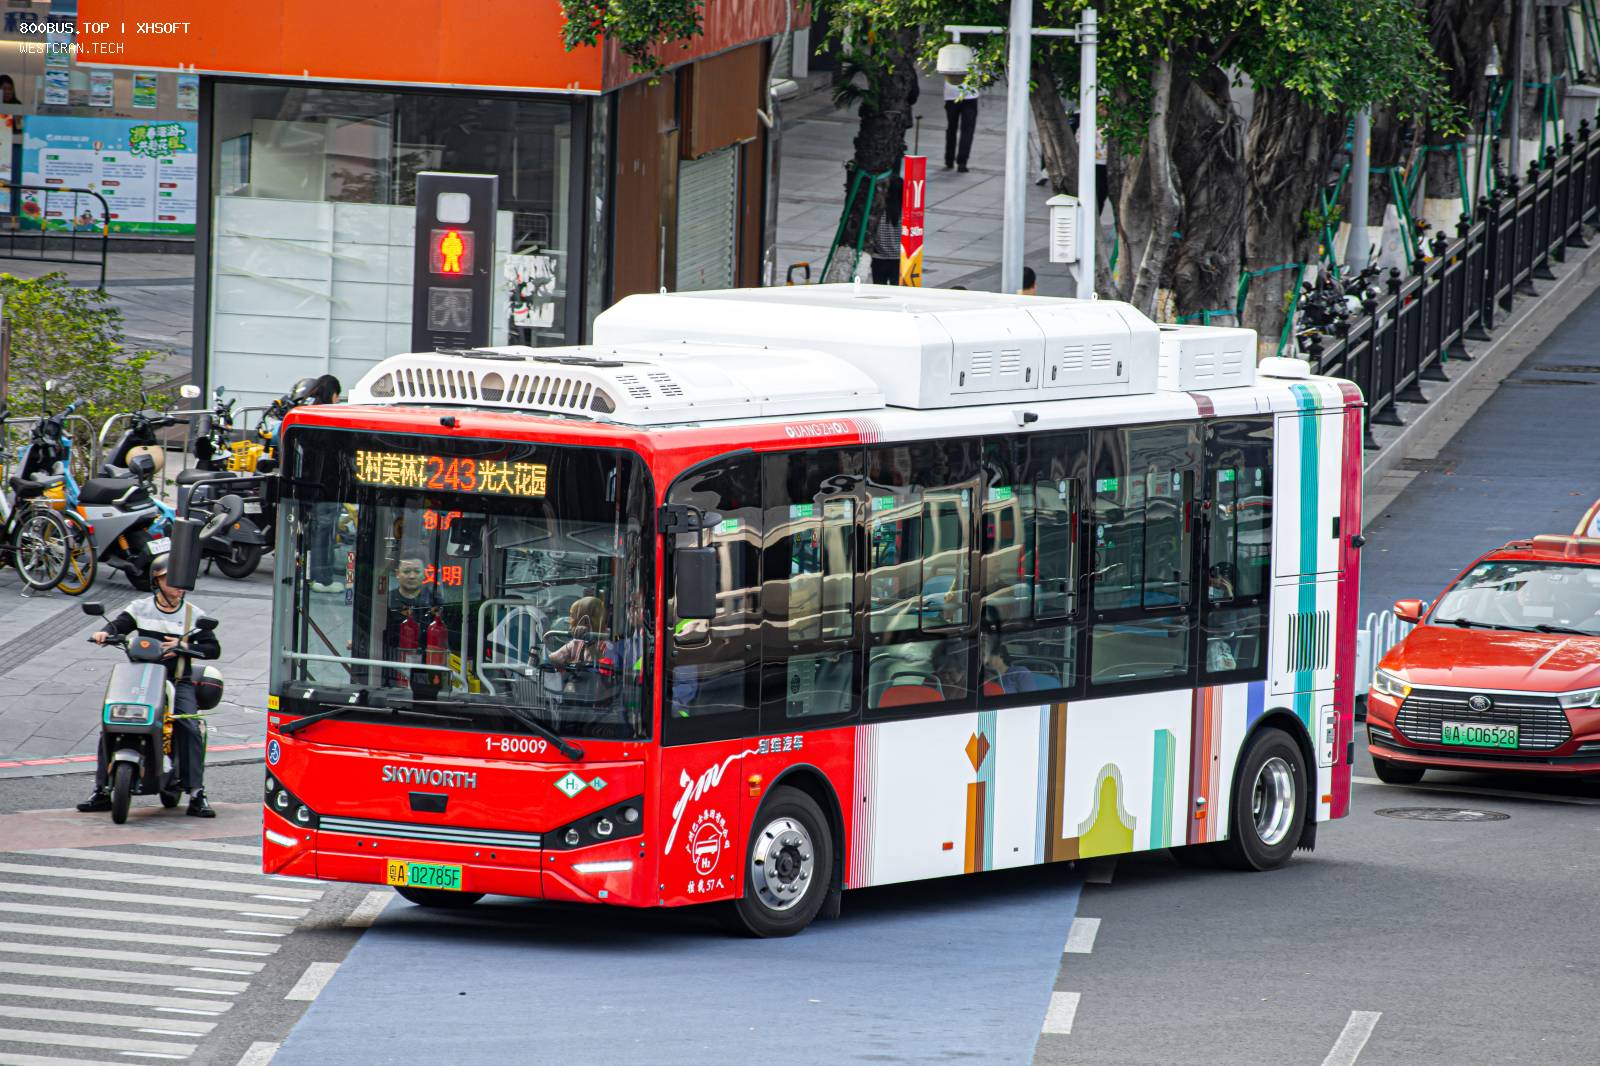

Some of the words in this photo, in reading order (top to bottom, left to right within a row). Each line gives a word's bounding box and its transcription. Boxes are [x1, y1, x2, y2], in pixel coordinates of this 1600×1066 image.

[427, 456, 476, 490] 243
[478, 460, 547, 495] 光大花园
[422, 564, 462, 586] 文明
[485, 737, 547, 754] 1-80009
[382, 765, 477, 788] SKYWORTH
